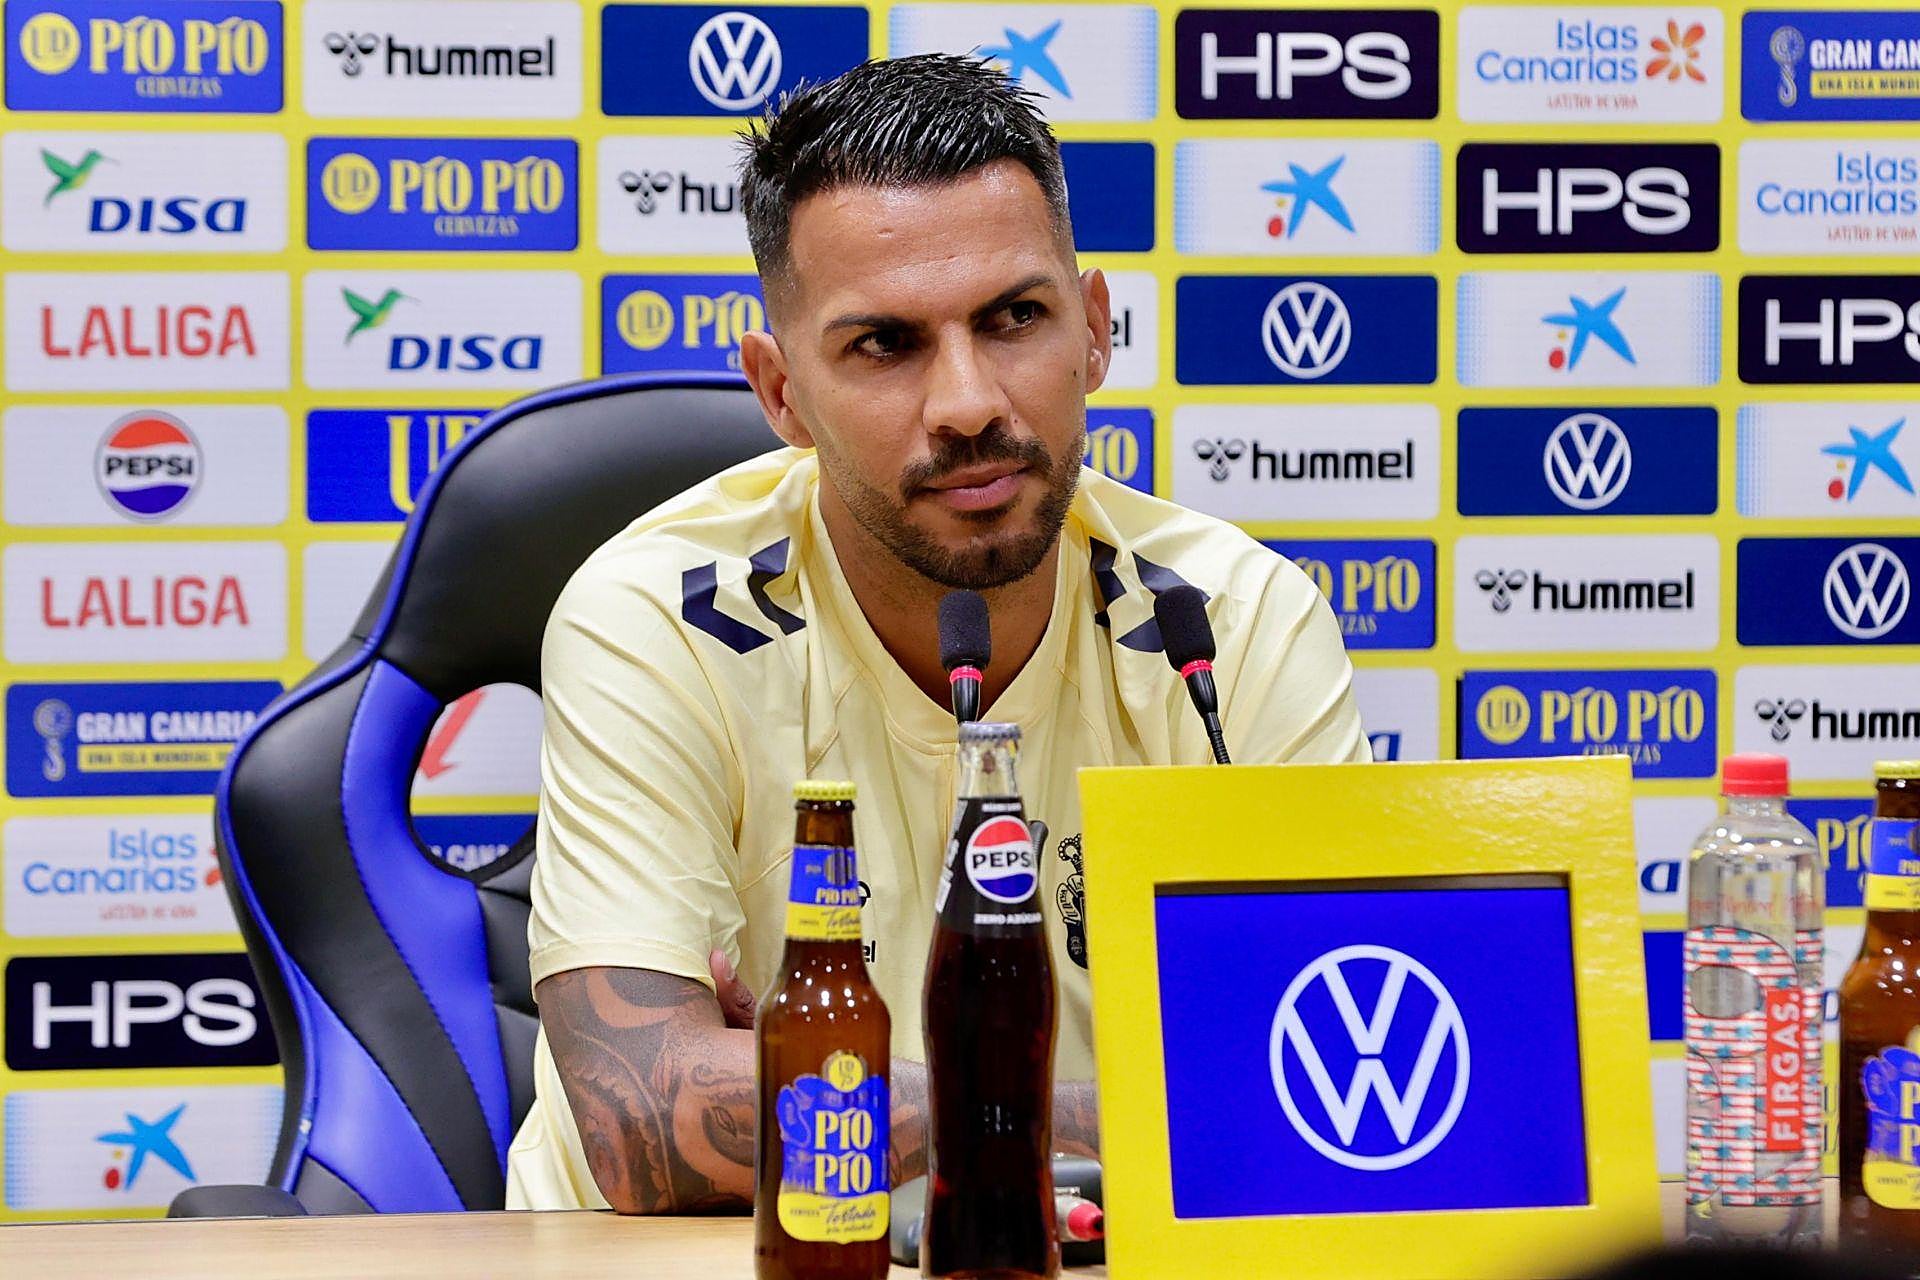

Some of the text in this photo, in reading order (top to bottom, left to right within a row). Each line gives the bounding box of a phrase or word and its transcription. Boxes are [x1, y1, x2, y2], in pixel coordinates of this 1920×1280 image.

[1556, 18, 1639, 51] Islas
[386, 38, 556, 77] hummel
[689, 12, 782, 110] VW
[1201, 32, 1412, 100] HPS
[1476, 48, 1639, 83] Canarias
[1810, 39, 1920, 71] GRAN CAN
[1837, 151, 1918, 183] Islas
[681, 173, 743, 213] hu
[1483, 168, 1690, 235] HPS
[1757, 179, 1918, 215] Canarias
[90, 199, 247, 233] DISA
[42, 306, 257, 357] LALIGA
[1262, 281, 1351, 379] VW
[1765, 299, 1920, 366] HP
[390, 336, 543, 370] DISA
[105, 456, 194, 478] PEPSI
[1252, 441, 1415, 479] hummel
[1543, 413, 1632, 509] VW
[42, 577, 249, 627] LALIGA
[1533, 570, 1695, 610] hummel
[1823, 543, 1911, 638] VW
[77, 712, 146, 743] GRAN
[109, 829, 197, 860] Islas
[23, 860, 197, 894] Canarias
[33, 978, 257, 1049] HPS
[1269, 944, 1470, 1171] VW
[1771, 992, 1800, 1141] FIRGAS.
